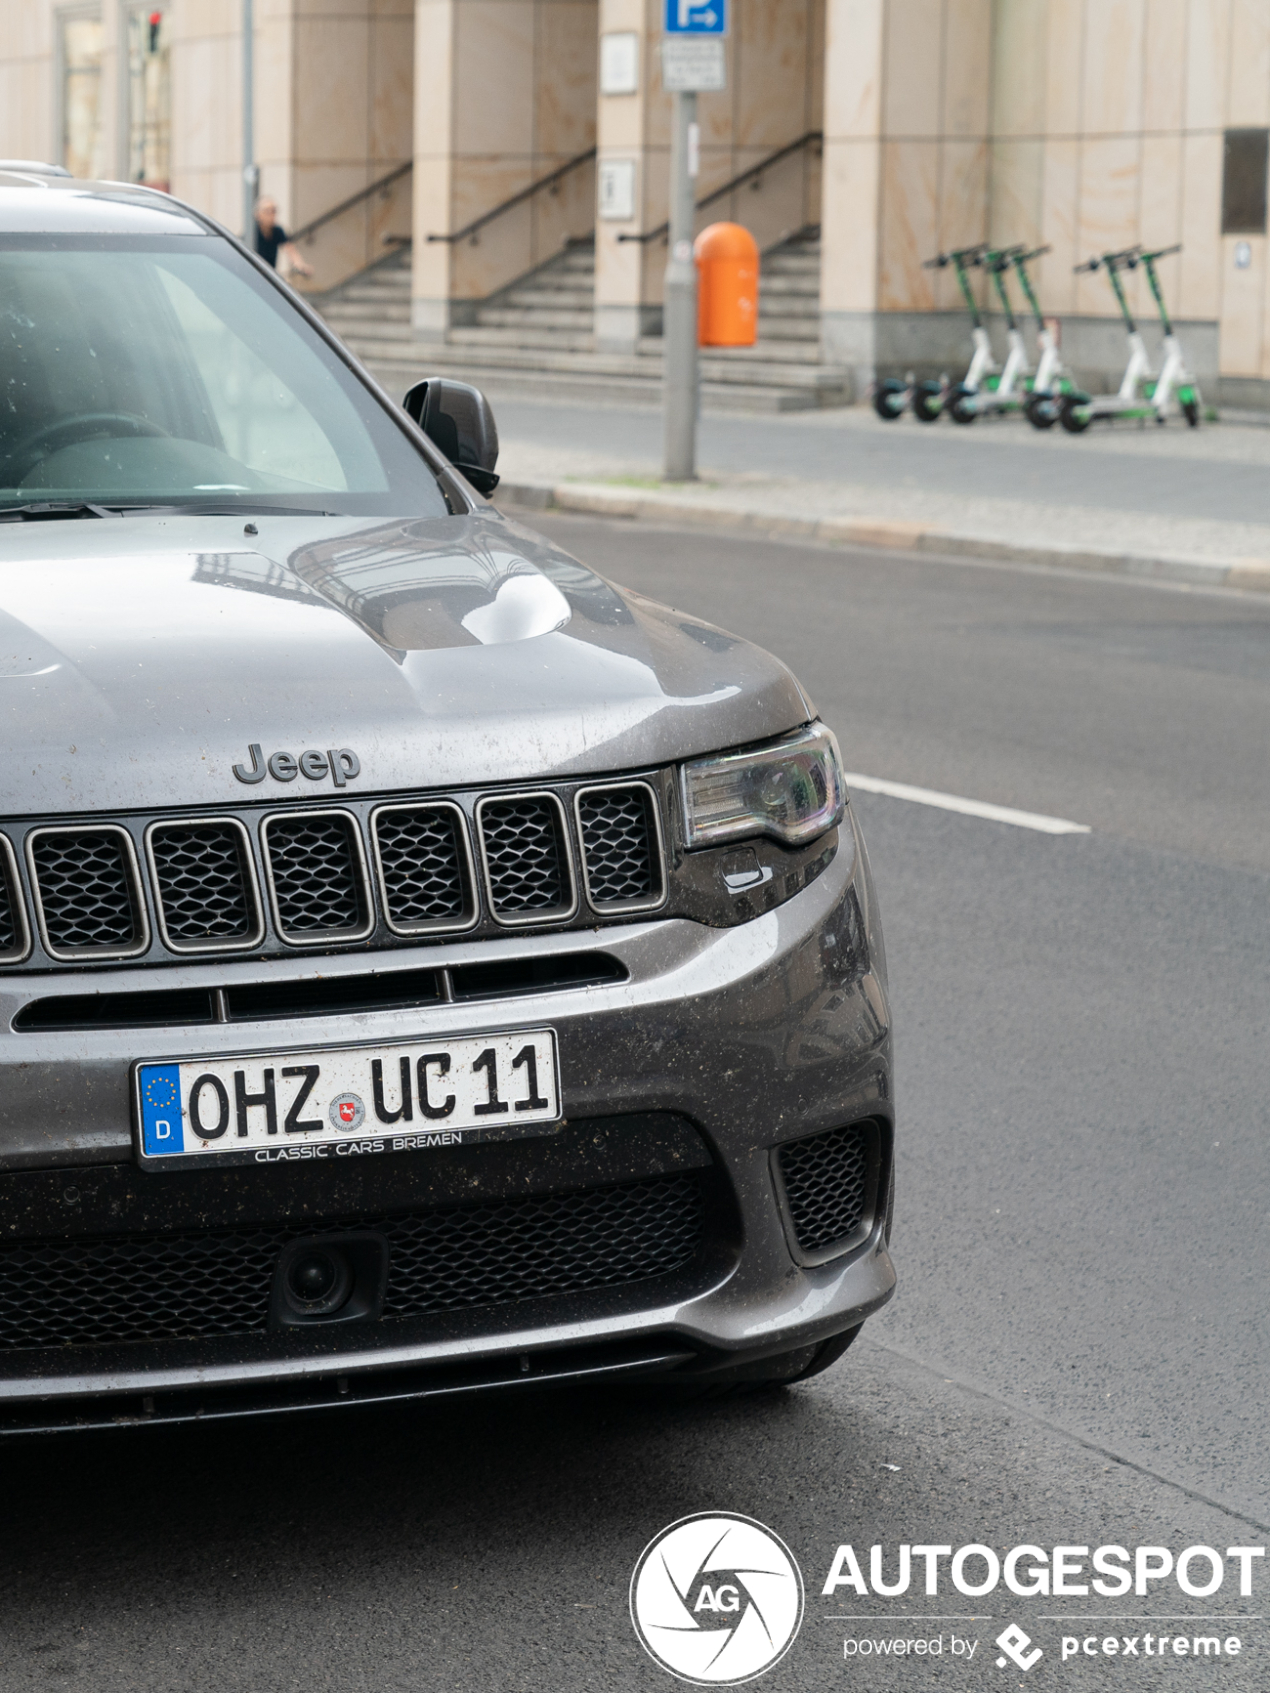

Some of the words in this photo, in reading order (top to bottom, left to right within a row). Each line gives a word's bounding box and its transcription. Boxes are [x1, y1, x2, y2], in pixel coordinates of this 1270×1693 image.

[232, 743, 361, 788] Jeep
[155, 1120, 171, 1140] D
[189, 1064, 324, 1140] OHZ
[371, 1052, 456, 1124] UC
[472, 1044, 549, 1116] 11
[254, 1144, 328, 1162] CLASSIC
[335, 1139, 385, 1157] CARS
[392, 1131, 462, 1151] BREMEN
